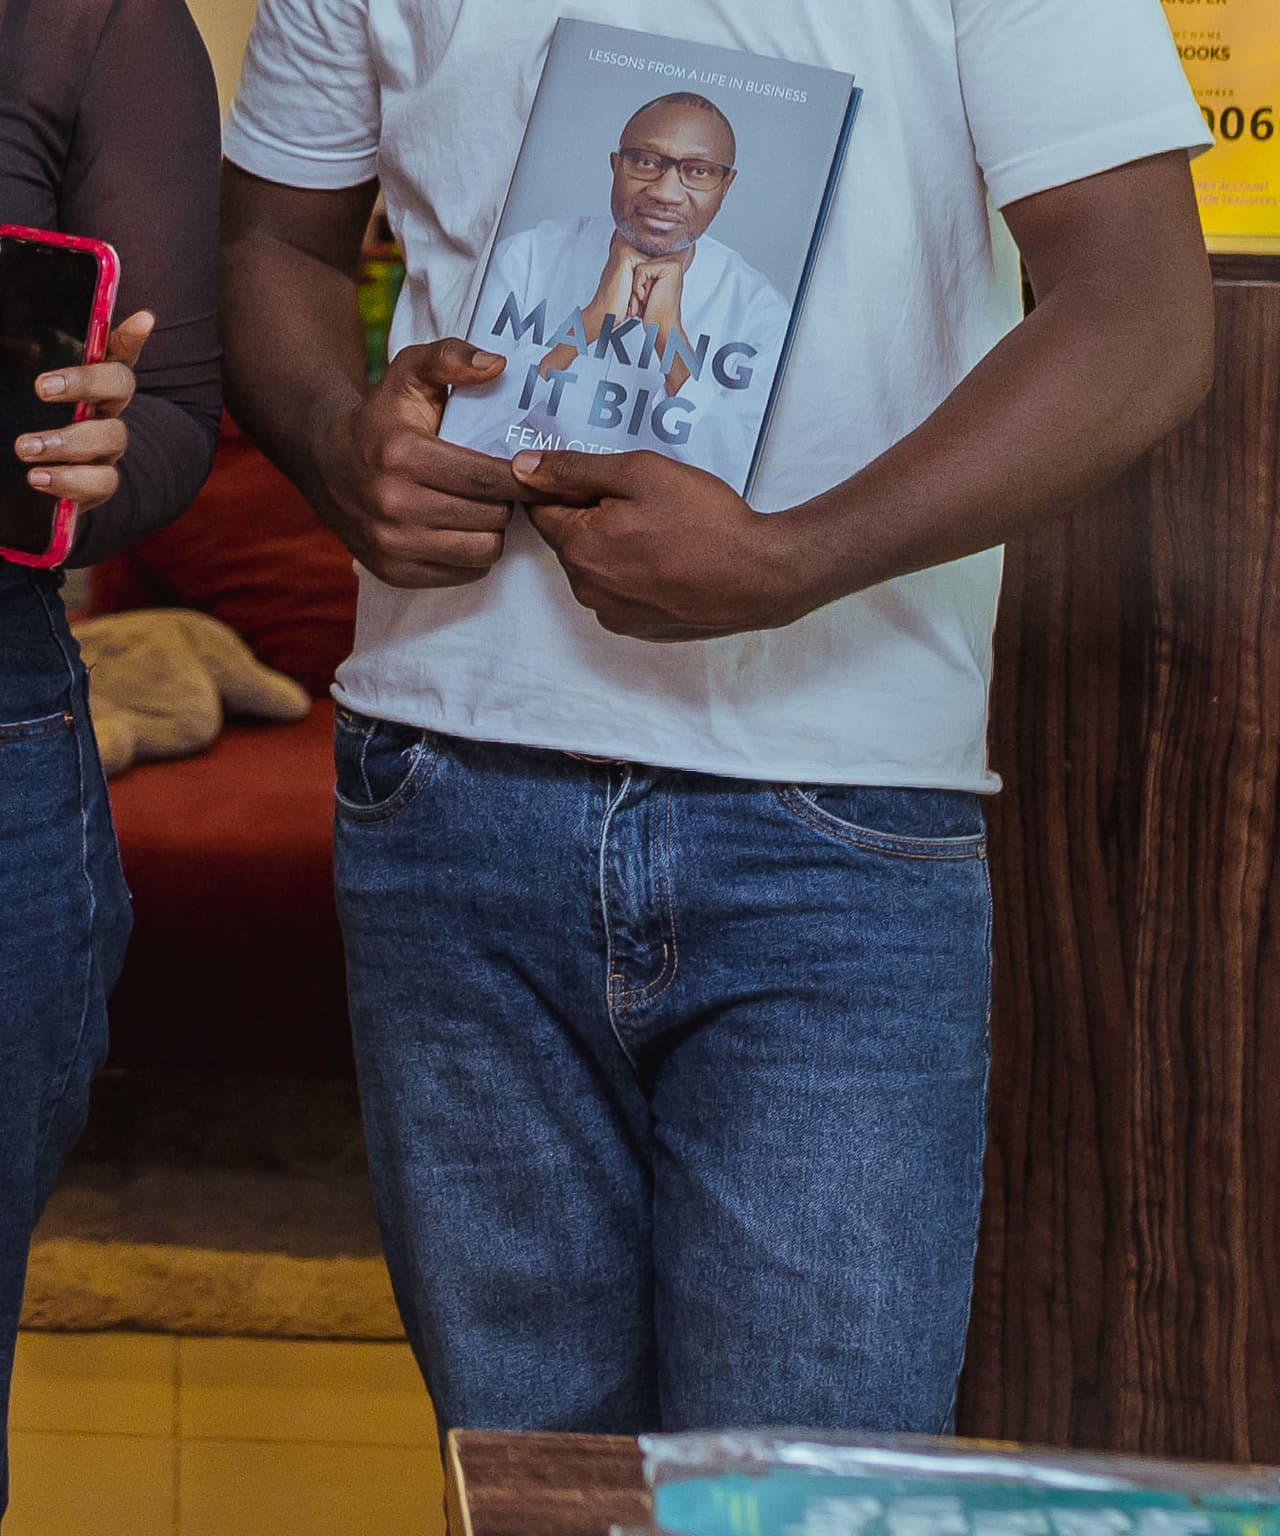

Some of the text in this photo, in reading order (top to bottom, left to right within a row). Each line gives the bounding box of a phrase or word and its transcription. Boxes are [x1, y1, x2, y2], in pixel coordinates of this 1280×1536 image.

[589, 49, 809, 104] LESSONS FROM A LIFE IN BUSINESS
[491, 291, 758, 391] MAKING
[518, 364, 697, 445] IT BIG
